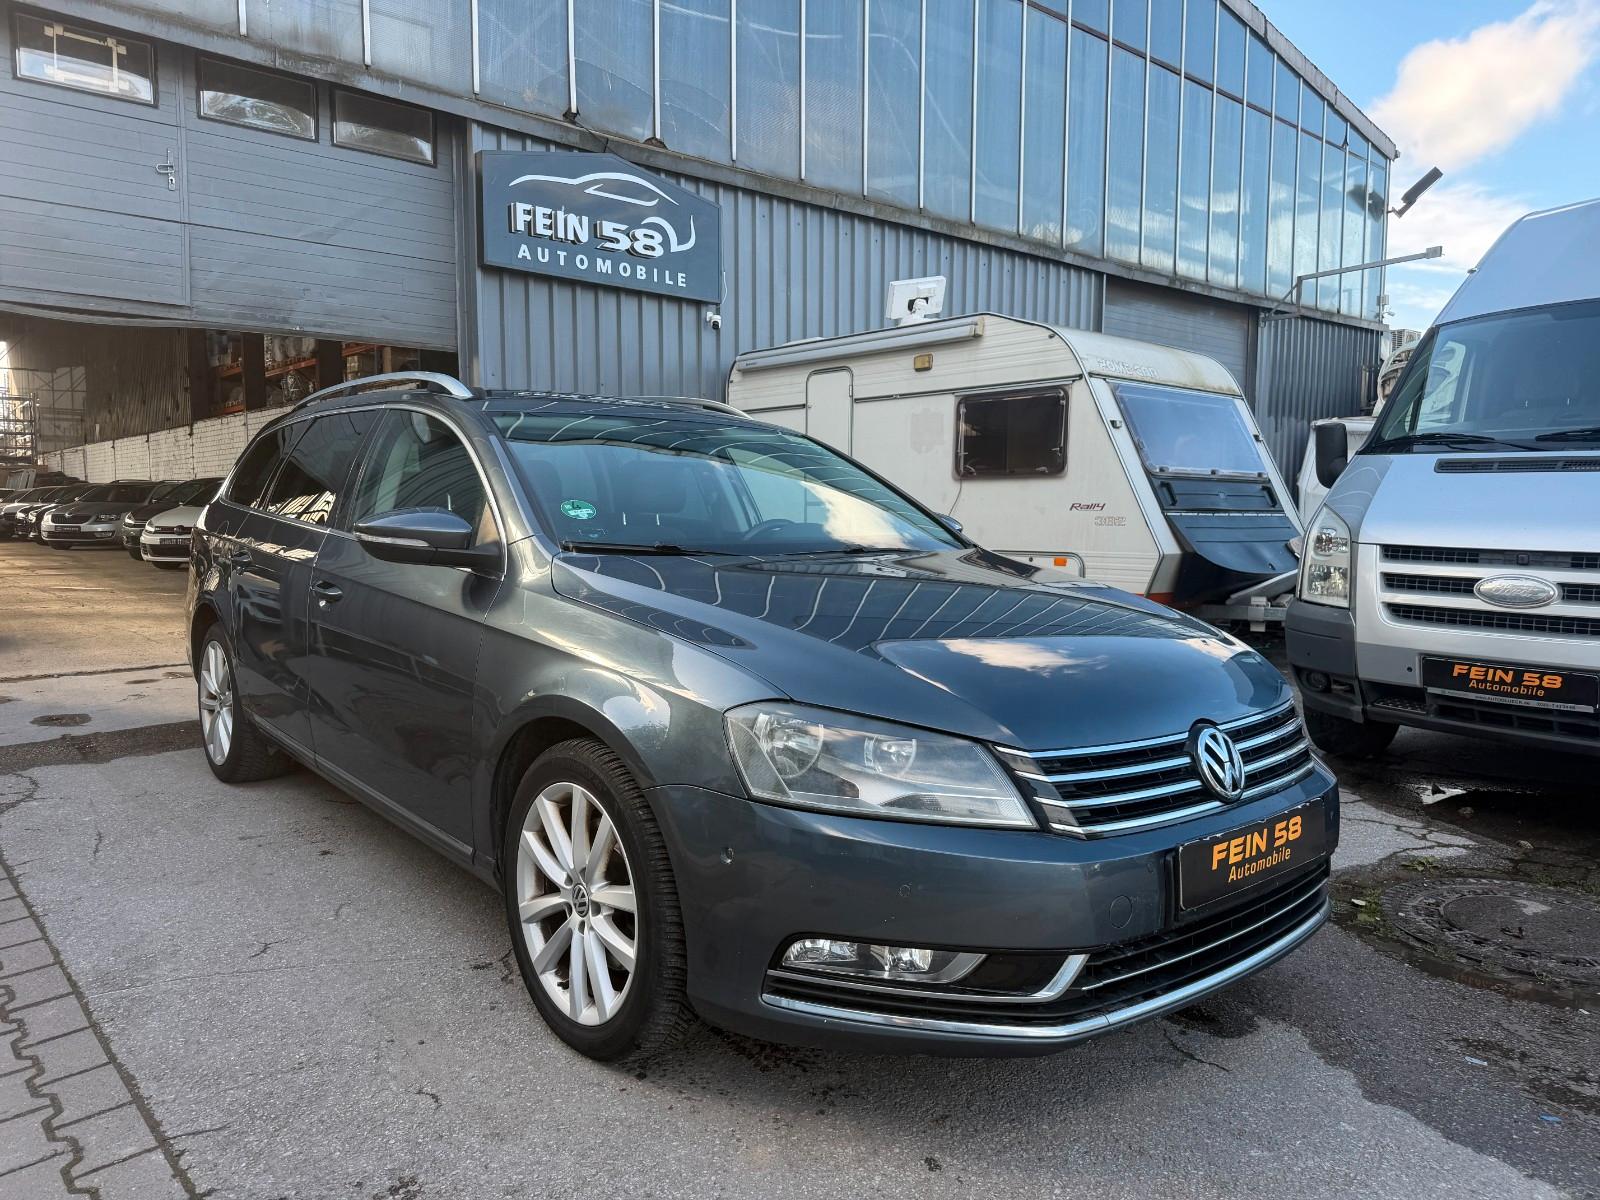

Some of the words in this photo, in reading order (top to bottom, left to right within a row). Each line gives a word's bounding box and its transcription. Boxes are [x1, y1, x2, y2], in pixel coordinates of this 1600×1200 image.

[510, 202, 589, 245] FEIN
[597, 220, 664, 259] 58
[517, 243, 687, 287] AUTOMOBILE
[1069, 502, 1106, 511] Rally
[1452, 664, 1513, 684] FEIN
[1521, 673, 1563, 689] 58
[1468, 679, 1545, 697] Automobile
[1211, 828, 1267, 871] FEIN
[1274, 815, 1303, 847] 58
[1228, 847, 1291, 883] Automobile
